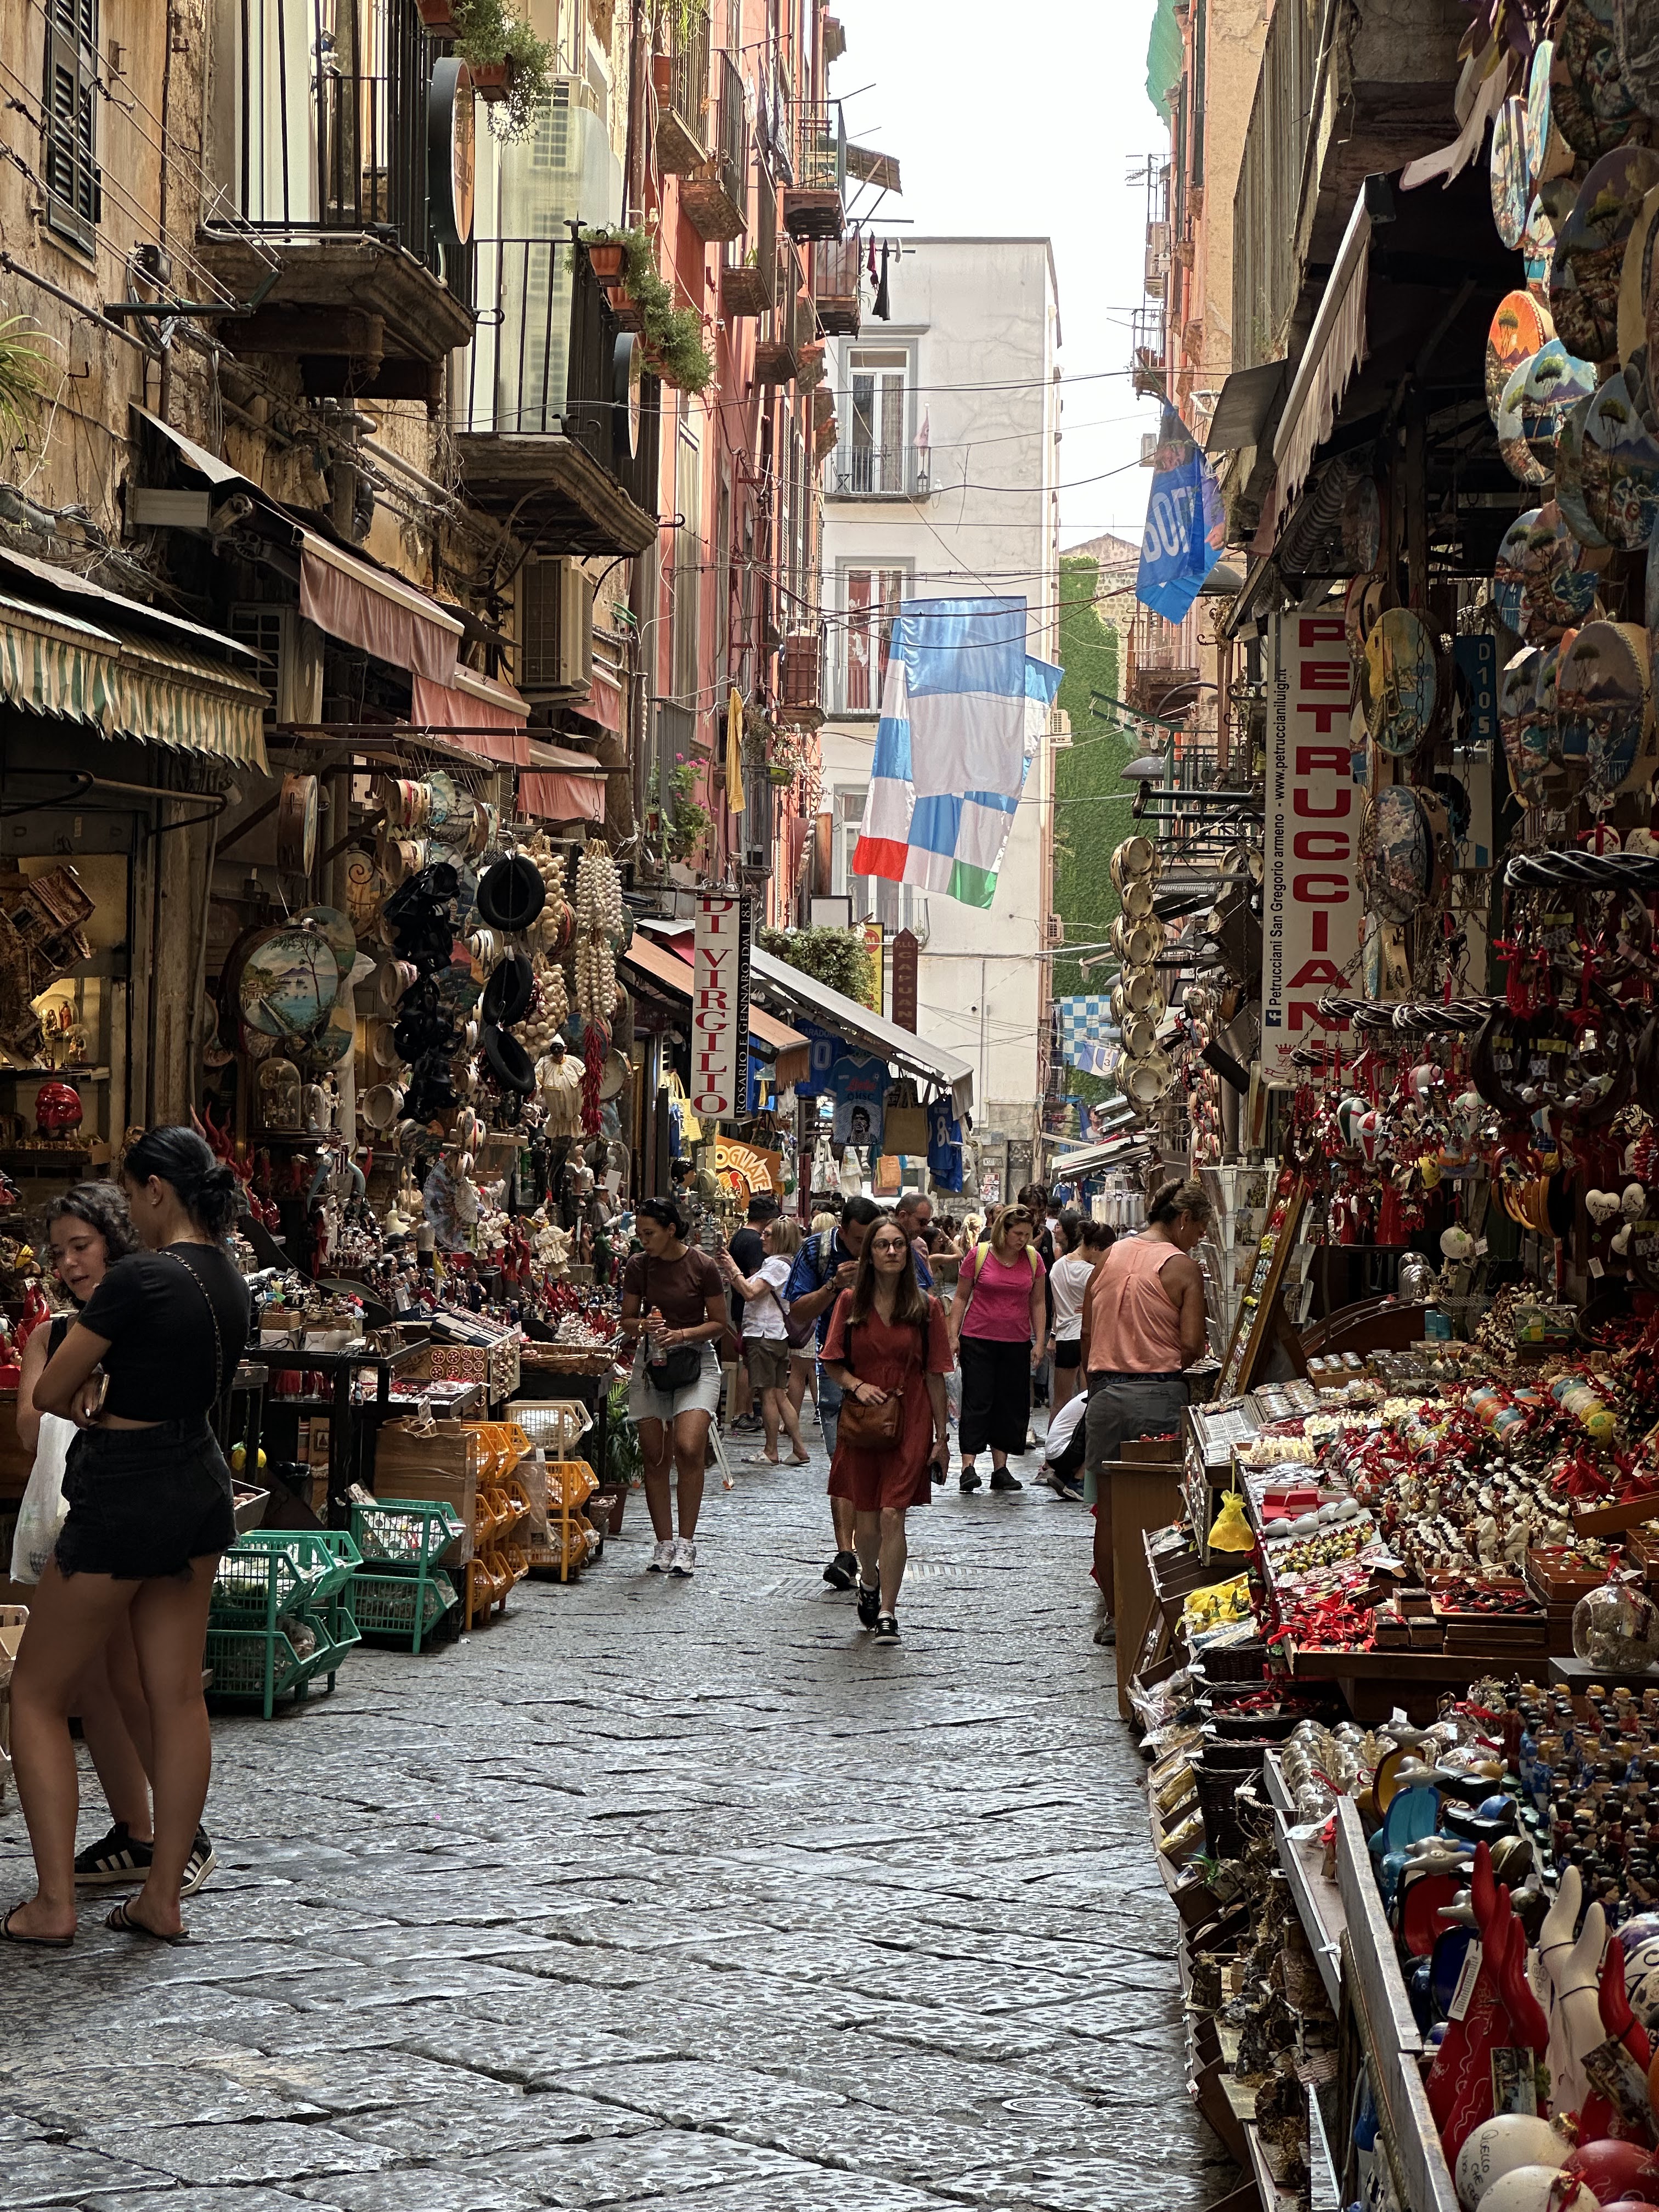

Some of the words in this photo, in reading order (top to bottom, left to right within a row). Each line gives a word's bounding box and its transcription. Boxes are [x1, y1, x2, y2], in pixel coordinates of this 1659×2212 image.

[1274, 813, 1284, 857] armeno
[1286, 618, 1353, 1077] PETRUCCIANI
[1270, 860, 1286, 912] Gregorio
[698, 894, 733, 934] DI
[1269, 915, 1283, 937] San
[741, 930, 751, 956] DAL
[1269, 941, 1282, 1006] Petrucciani
[738, 962, 750, 1035] GENNARO
[693, 948, 733, 1114] VIRGILIO
[736, 1052, 748, 1114] ROSARIO
[1471, 2163, 1484, 2186] CHE
[1480, 2129, 1499, 2173] QUELLO
